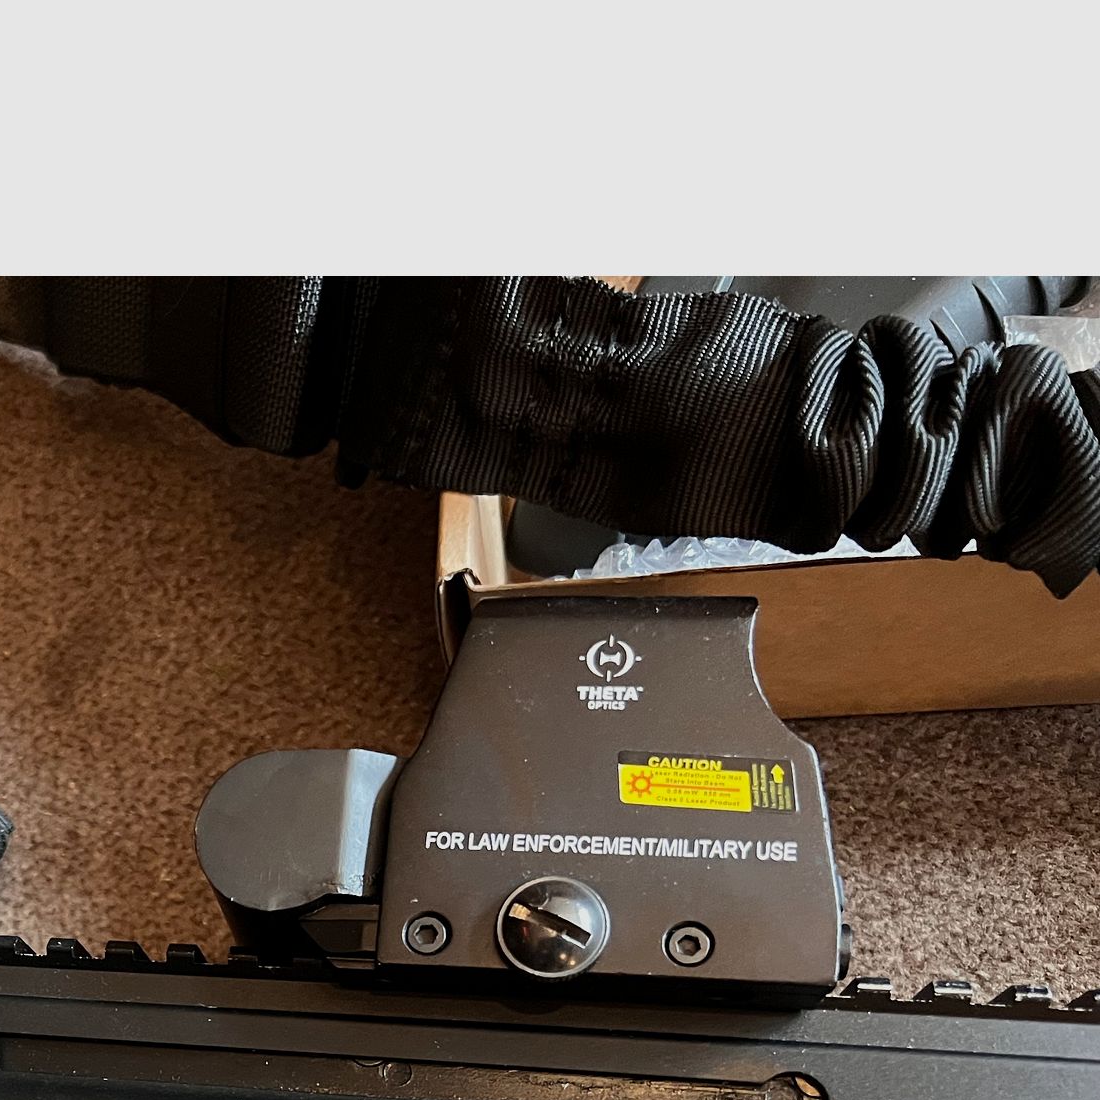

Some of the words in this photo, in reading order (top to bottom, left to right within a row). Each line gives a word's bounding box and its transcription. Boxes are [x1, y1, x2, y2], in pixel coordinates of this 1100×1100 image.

[576, 686, 639, 701] THETA
[587, 700, 626, 710] OPTICS
[648, 756, 723, 771] CAUTION
[425, 831, 465, 850] FOR
[468, 832, 510, 852] LAW
[512, 834, 753, 860] ENFORCEMENT/MILITARY
[756, 840, 798, 862] USE
